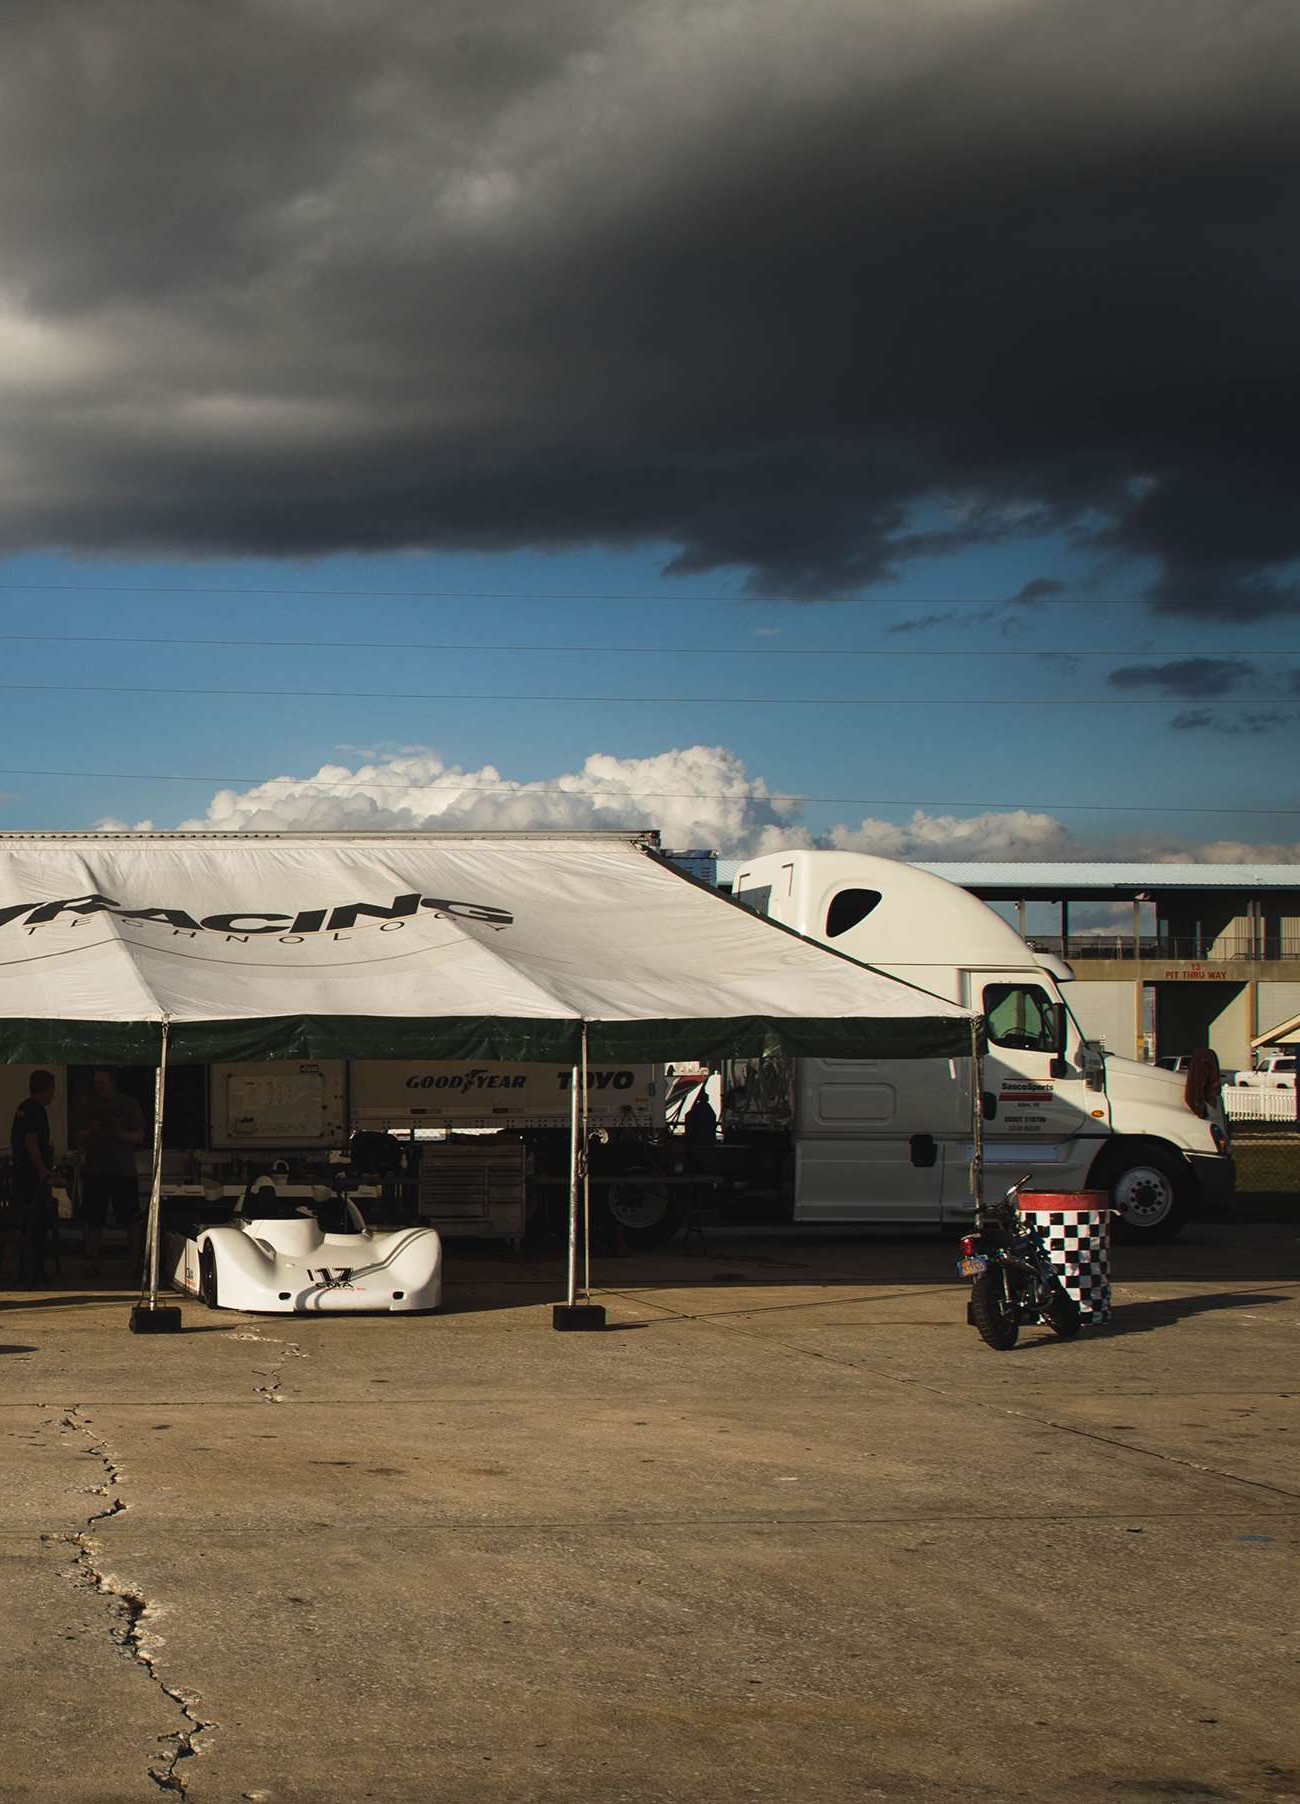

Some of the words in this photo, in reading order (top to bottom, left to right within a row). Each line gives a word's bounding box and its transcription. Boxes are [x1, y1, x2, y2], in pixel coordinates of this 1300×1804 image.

[23, 893, 514, 934] RACING
[21, 911, 508, 945] TECHNOLOGY
[1165, 971, 1179, 979] PIT
[1207, 971, 1227, 979] WAY
[1002, 1082, 1054, 1092] SascoSports
